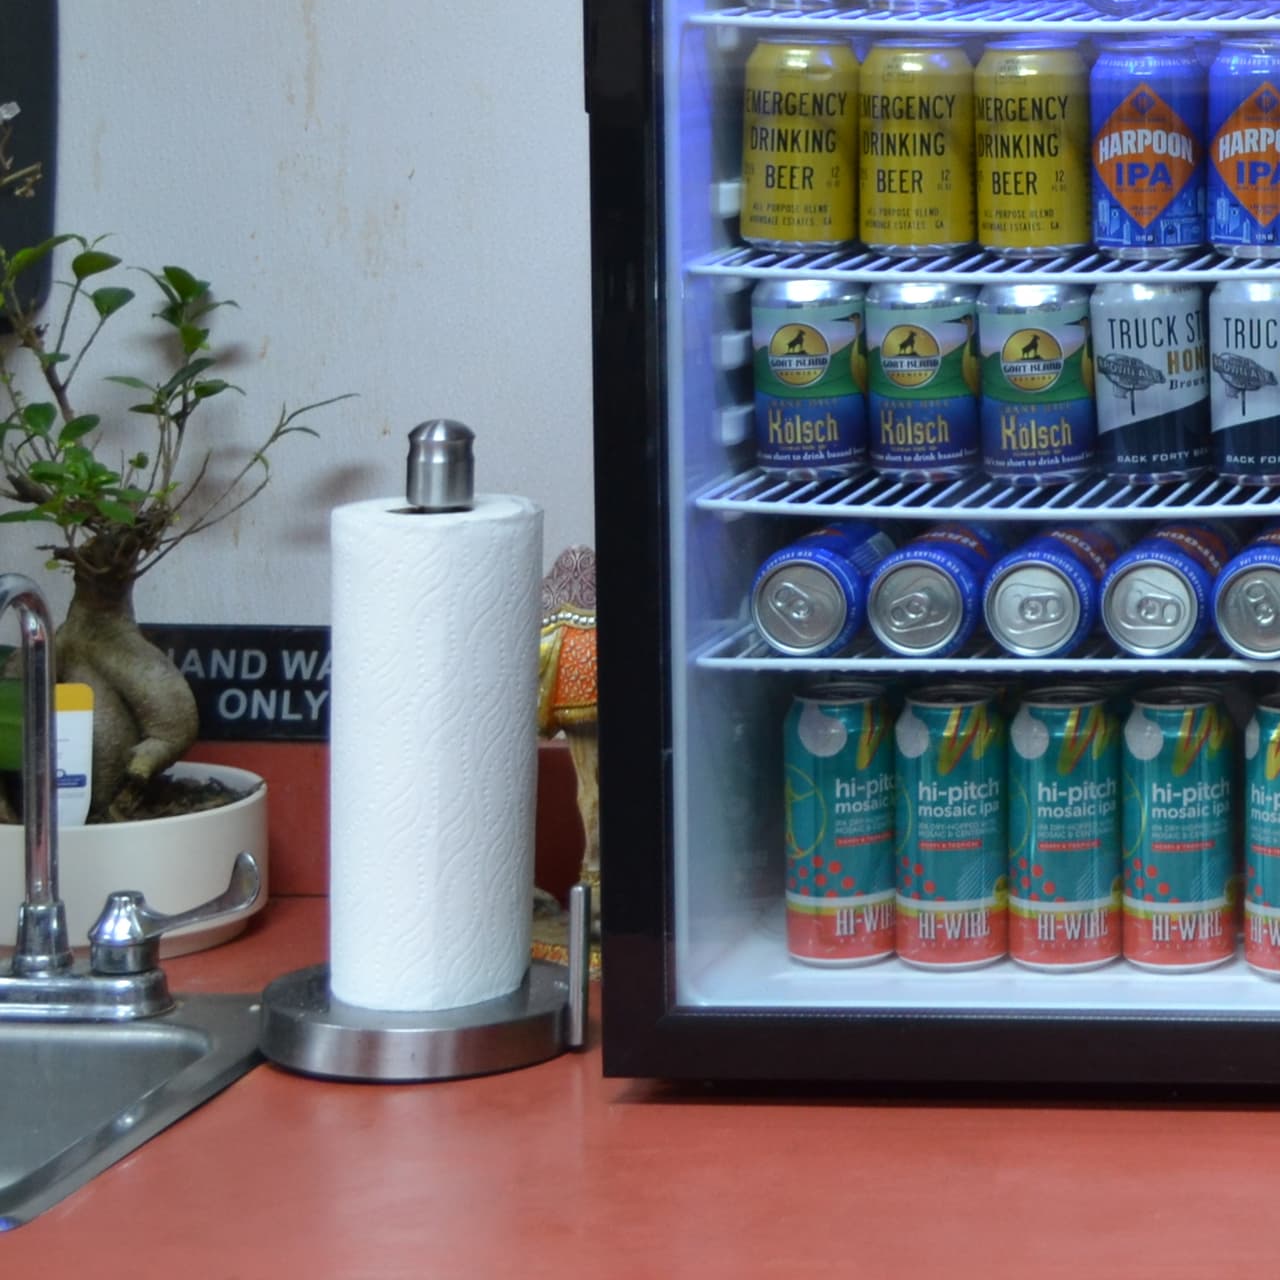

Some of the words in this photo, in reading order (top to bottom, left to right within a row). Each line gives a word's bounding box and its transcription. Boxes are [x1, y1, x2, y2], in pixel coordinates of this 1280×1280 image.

[751, 127, 837, 153] DRINKING
[977, 133, 1059, 158] DRINKING
[1099, 129, 1193, 165] HARPOON
[765, 165, 814, 189] BEER
[992, 171, 1038, 195] BEER
[1115, 162, 1172, 186] IPA
[1108, 315, 1178, 349] TRUCK
[1001, 415, 1072, 450] Kölsch
[1226, 455, 1254, 464] BACK
[219, 689, 329, 720] ONLY
[918, 778, 999, 804] hi-pitch
[918, 805, 976, 818] mosaic
[919, 909, 990, 940] HI-WIRE
